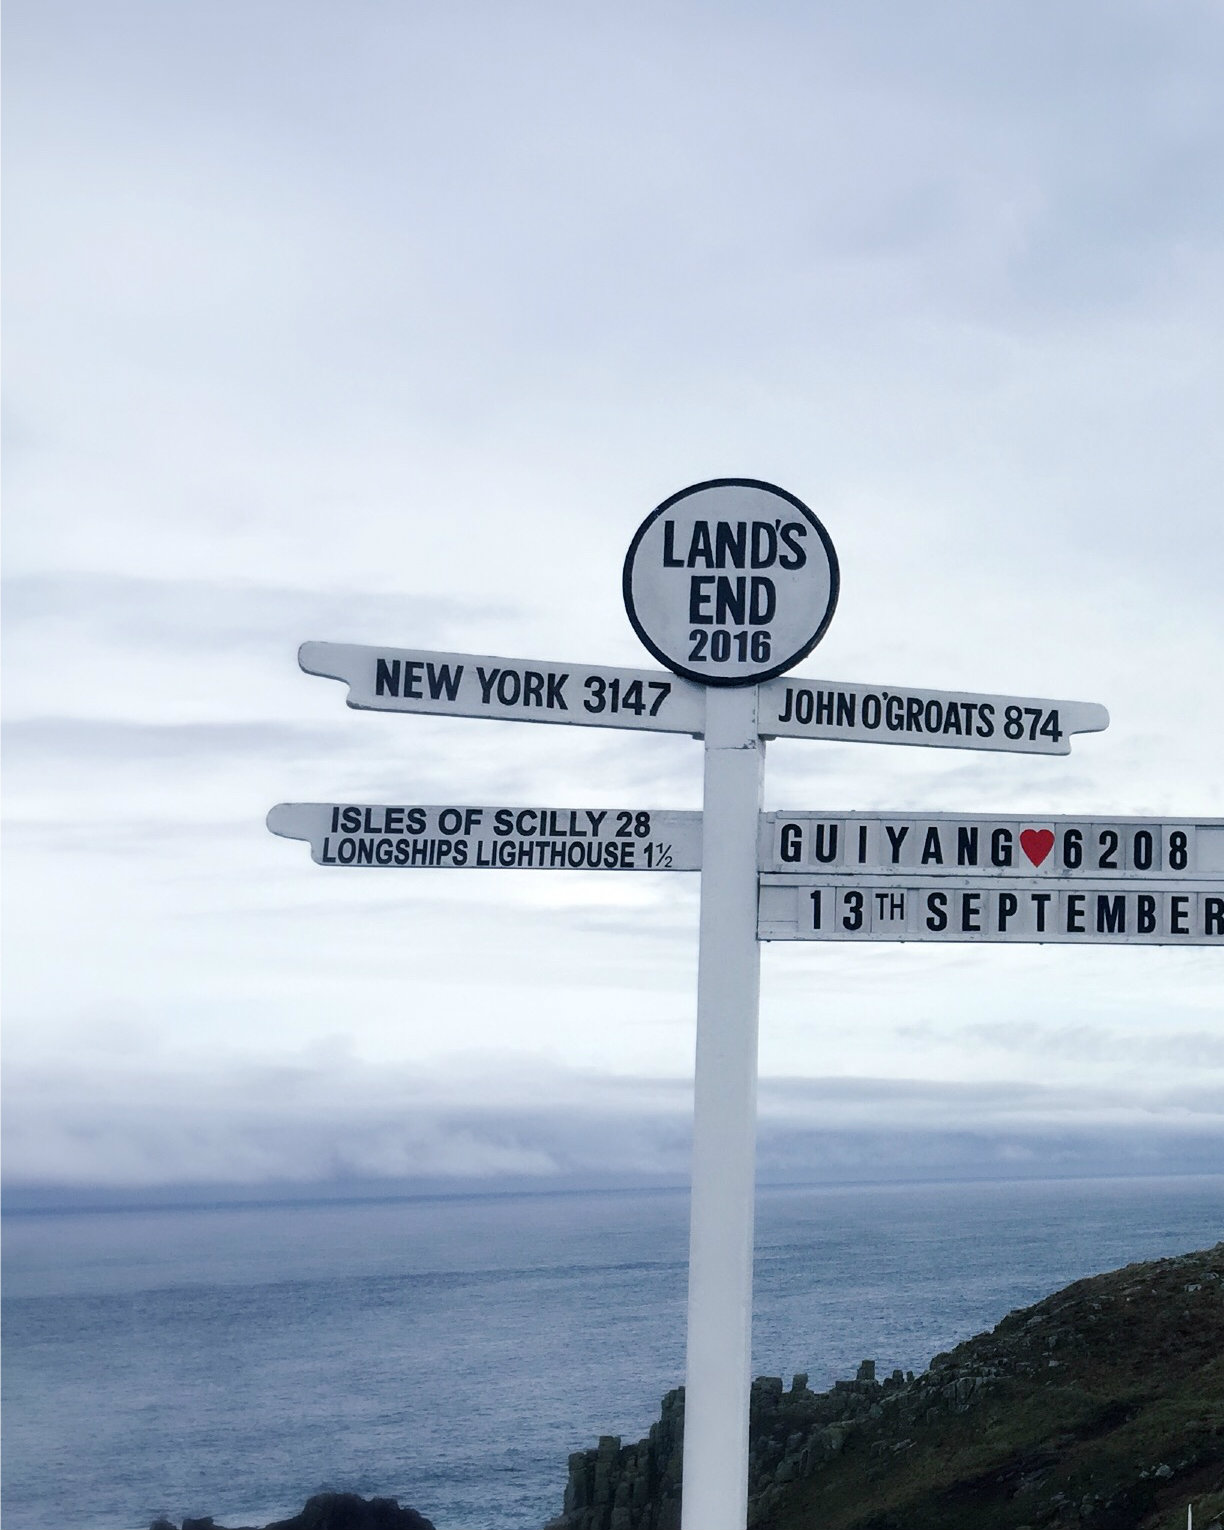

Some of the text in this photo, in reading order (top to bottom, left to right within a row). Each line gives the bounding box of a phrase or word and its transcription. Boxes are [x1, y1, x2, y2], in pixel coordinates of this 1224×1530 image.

[664, 519, 807, 570] LAND'S
[690, 576, 776, 625] END
[689, 629, 771, 663] 2016
[376, 659, 671, 716] NEW YORK 3147
[779, 688, 1062, 742] JOHN O'GROATS 874
[332, 807, 650, 838] ISLES OF SCILLY 28
[323, 838, 467, 865] LONGSHIPS
[476, 841, 635, 868] LIGHTHOUSE
[781, 824, 1187, 870] GUIYANG 6208
[810, 890, 1224, 935] 13TH SEPTEMBER
